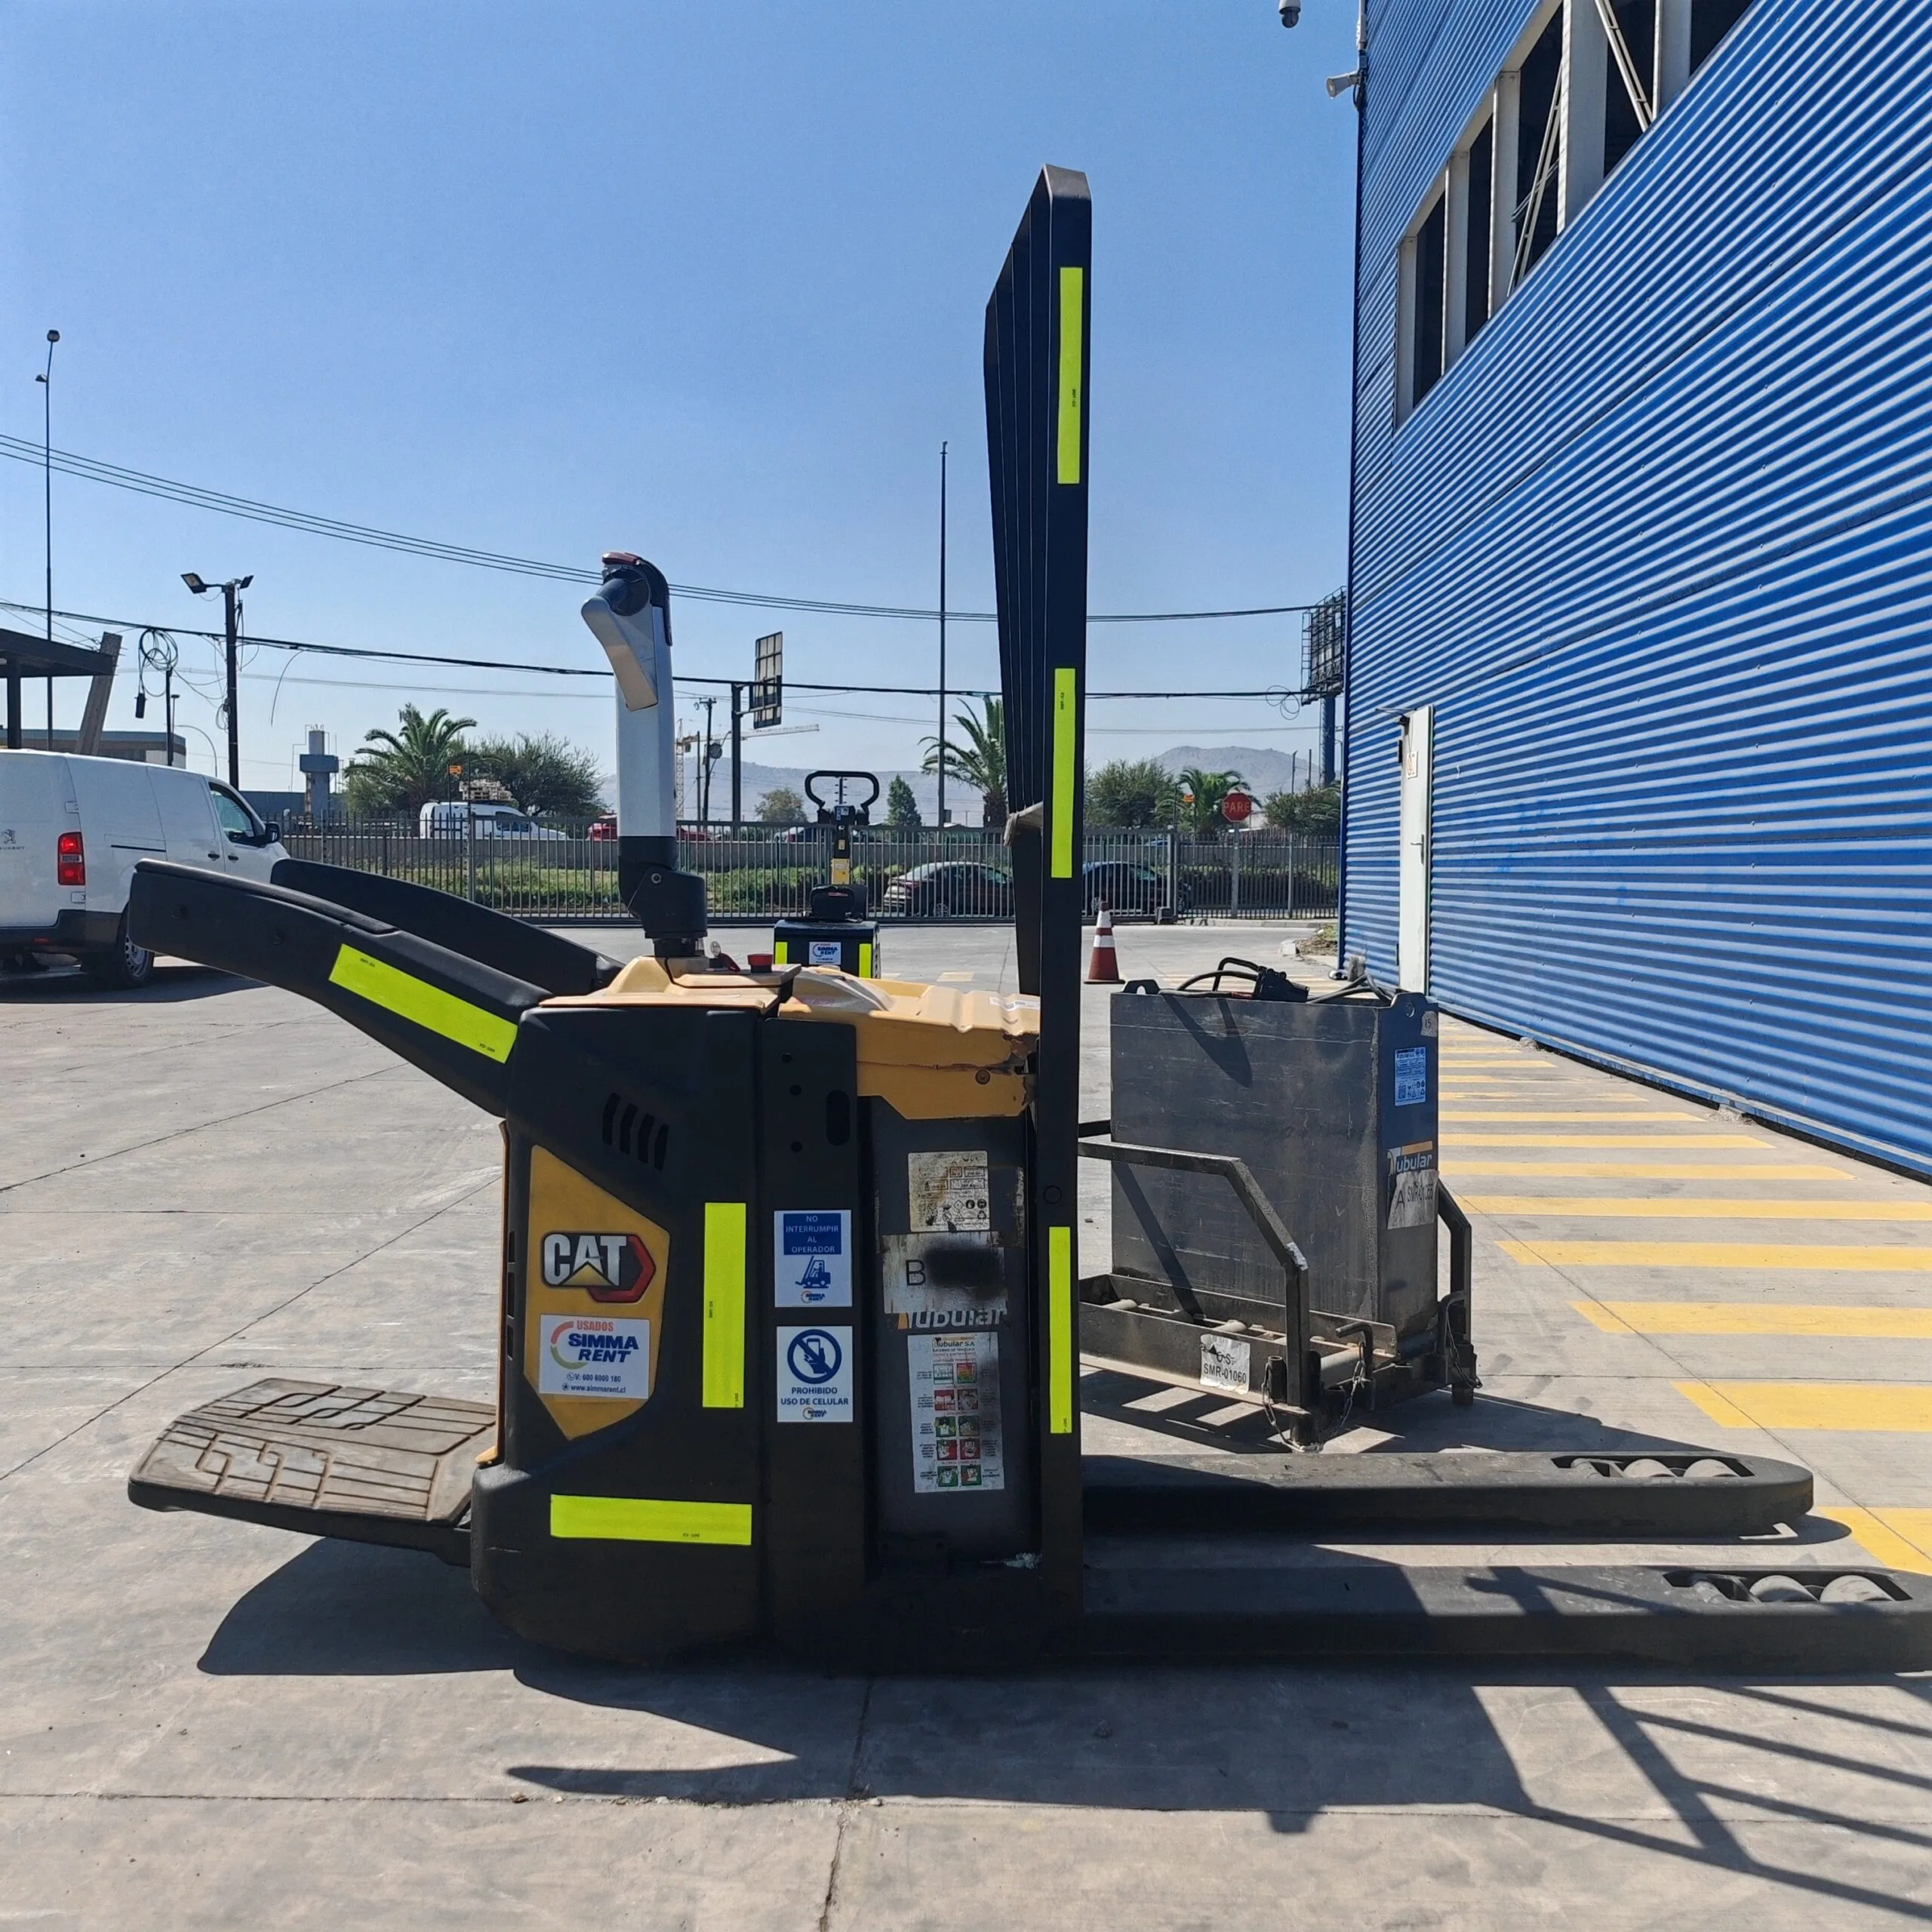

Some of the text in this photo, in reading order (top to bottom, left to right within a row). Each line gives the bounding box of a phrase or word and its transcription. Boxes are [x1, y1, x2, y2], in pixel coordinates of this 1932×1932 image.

[1223, 801, 1251, 814] PARE
[1387, 1147, 1432, 1176] Tubular
[1395, 1190, 1405, 1211] A
[543, 1234, 627, 1287] CAT
[577, 1320, 614, 1332] USADOS
[568, 1333, 639, 1350] SIMMA
[578, 1349, 631, 1363] RENT
[1204, 1363, 1247, 1384] SMR-01060
[571, 1385, 626, 1393] www.simmarent.cl
